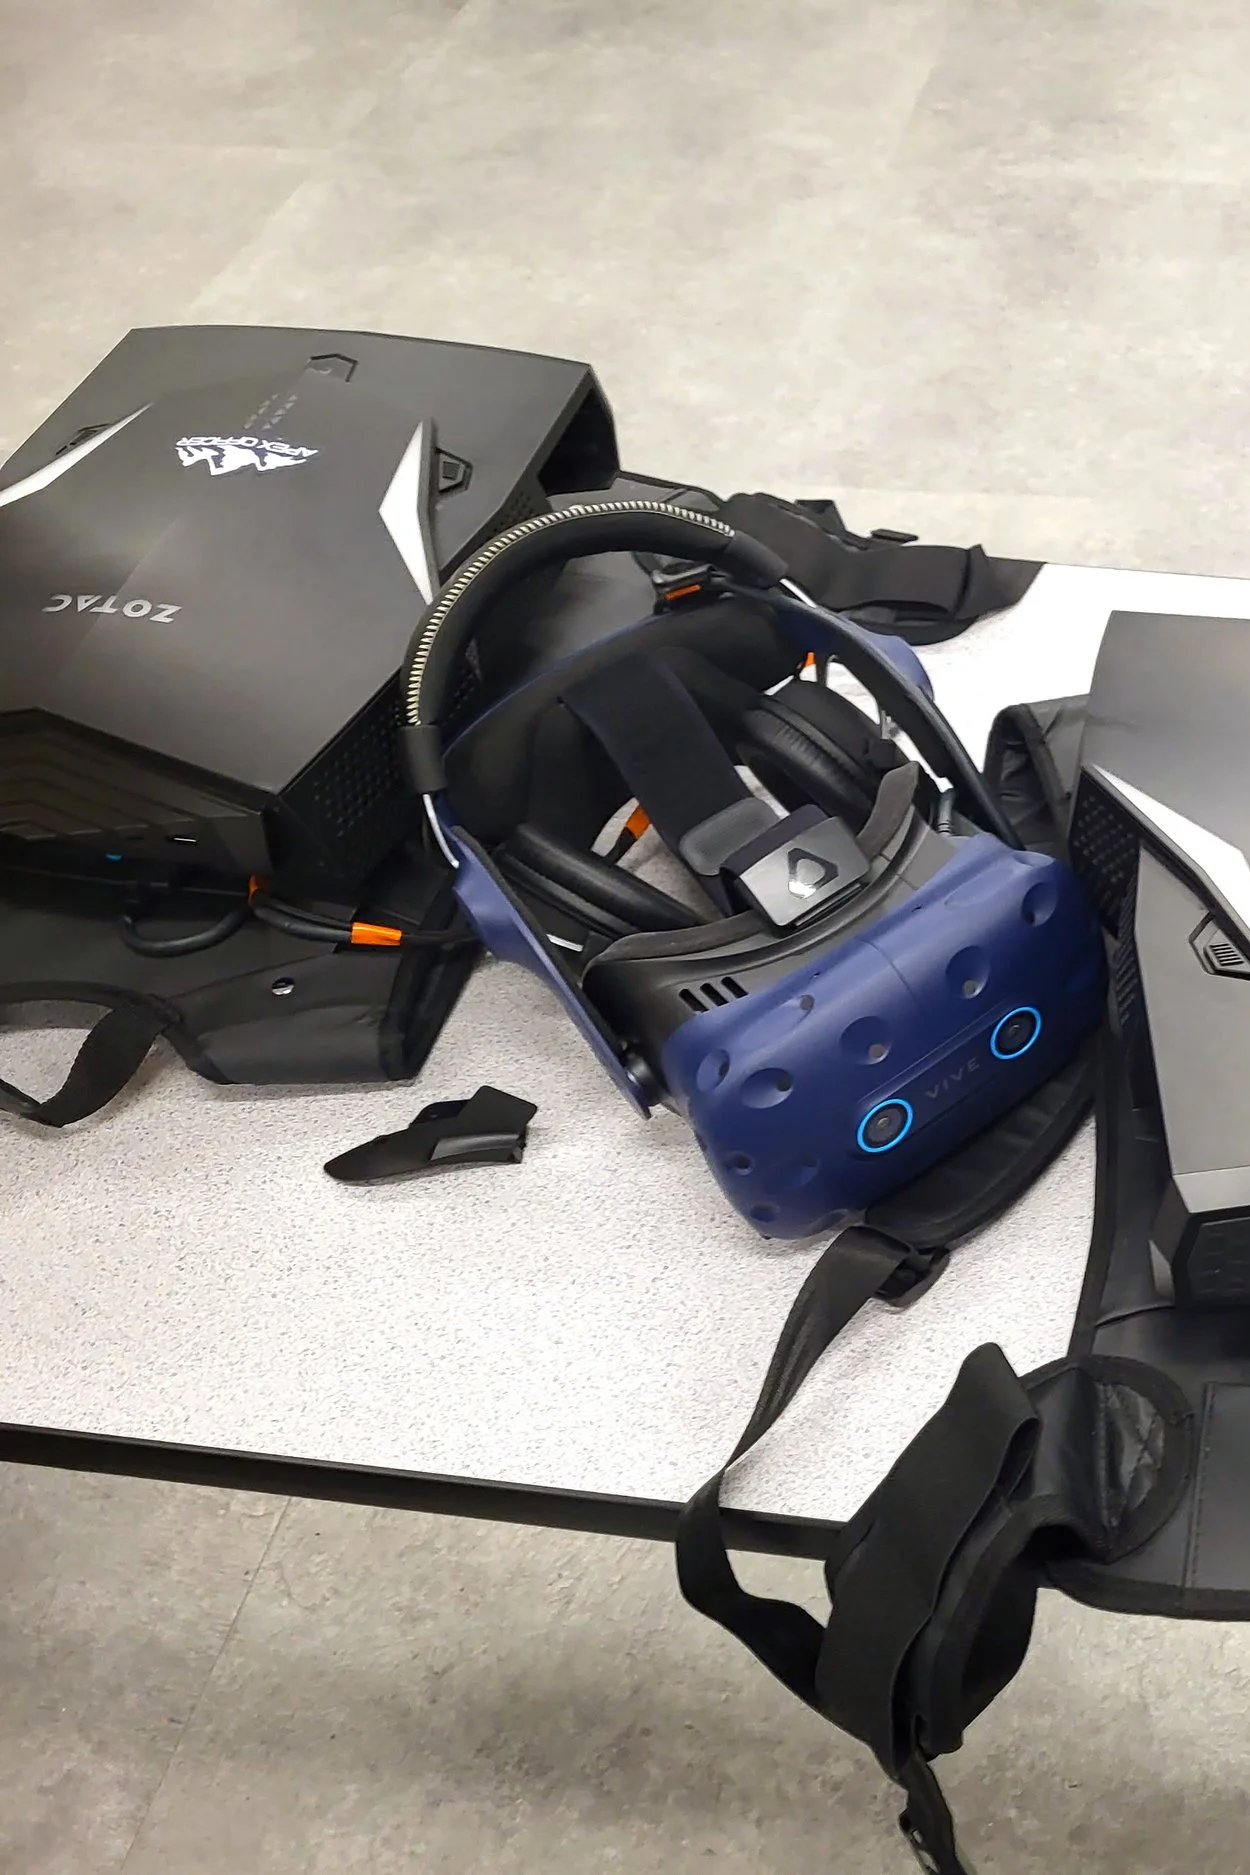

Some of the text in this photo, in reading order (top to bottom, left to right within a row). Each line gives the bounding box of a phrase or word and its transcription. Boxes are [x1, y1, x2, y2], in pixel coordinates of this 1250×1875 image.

[176, 437, 318, 457] APEX OFFICER
[41, 594, 182, 623] ZOTAC
[925, 1057, 979, 1099] VIVE
